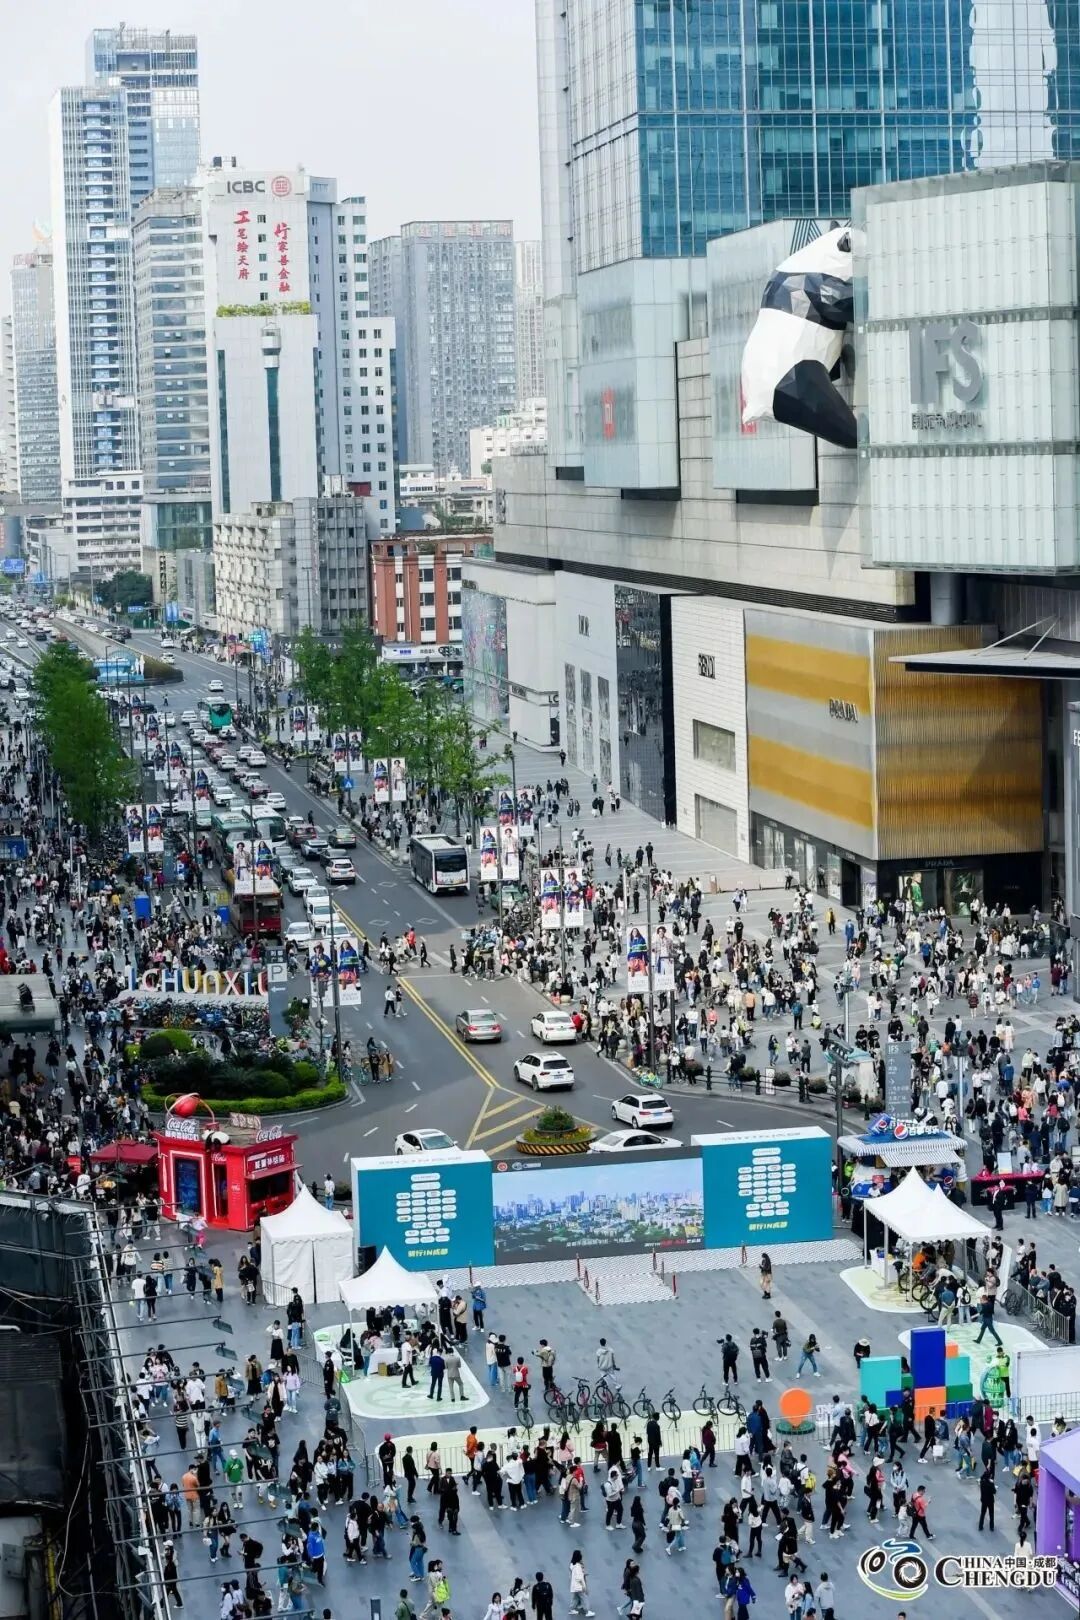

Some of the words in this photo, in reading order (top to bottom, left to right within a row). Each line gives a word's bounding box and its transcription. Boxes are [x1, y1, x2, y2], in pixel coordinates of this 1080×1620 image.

[227, 181, 265, 193] ICBC
[233, 210, 251, 280] 工笔绘天府
[909, 320, 981, 404] IFS
[829, 698, 858, 723] PRADA
[271, 964, 283, 981] P
